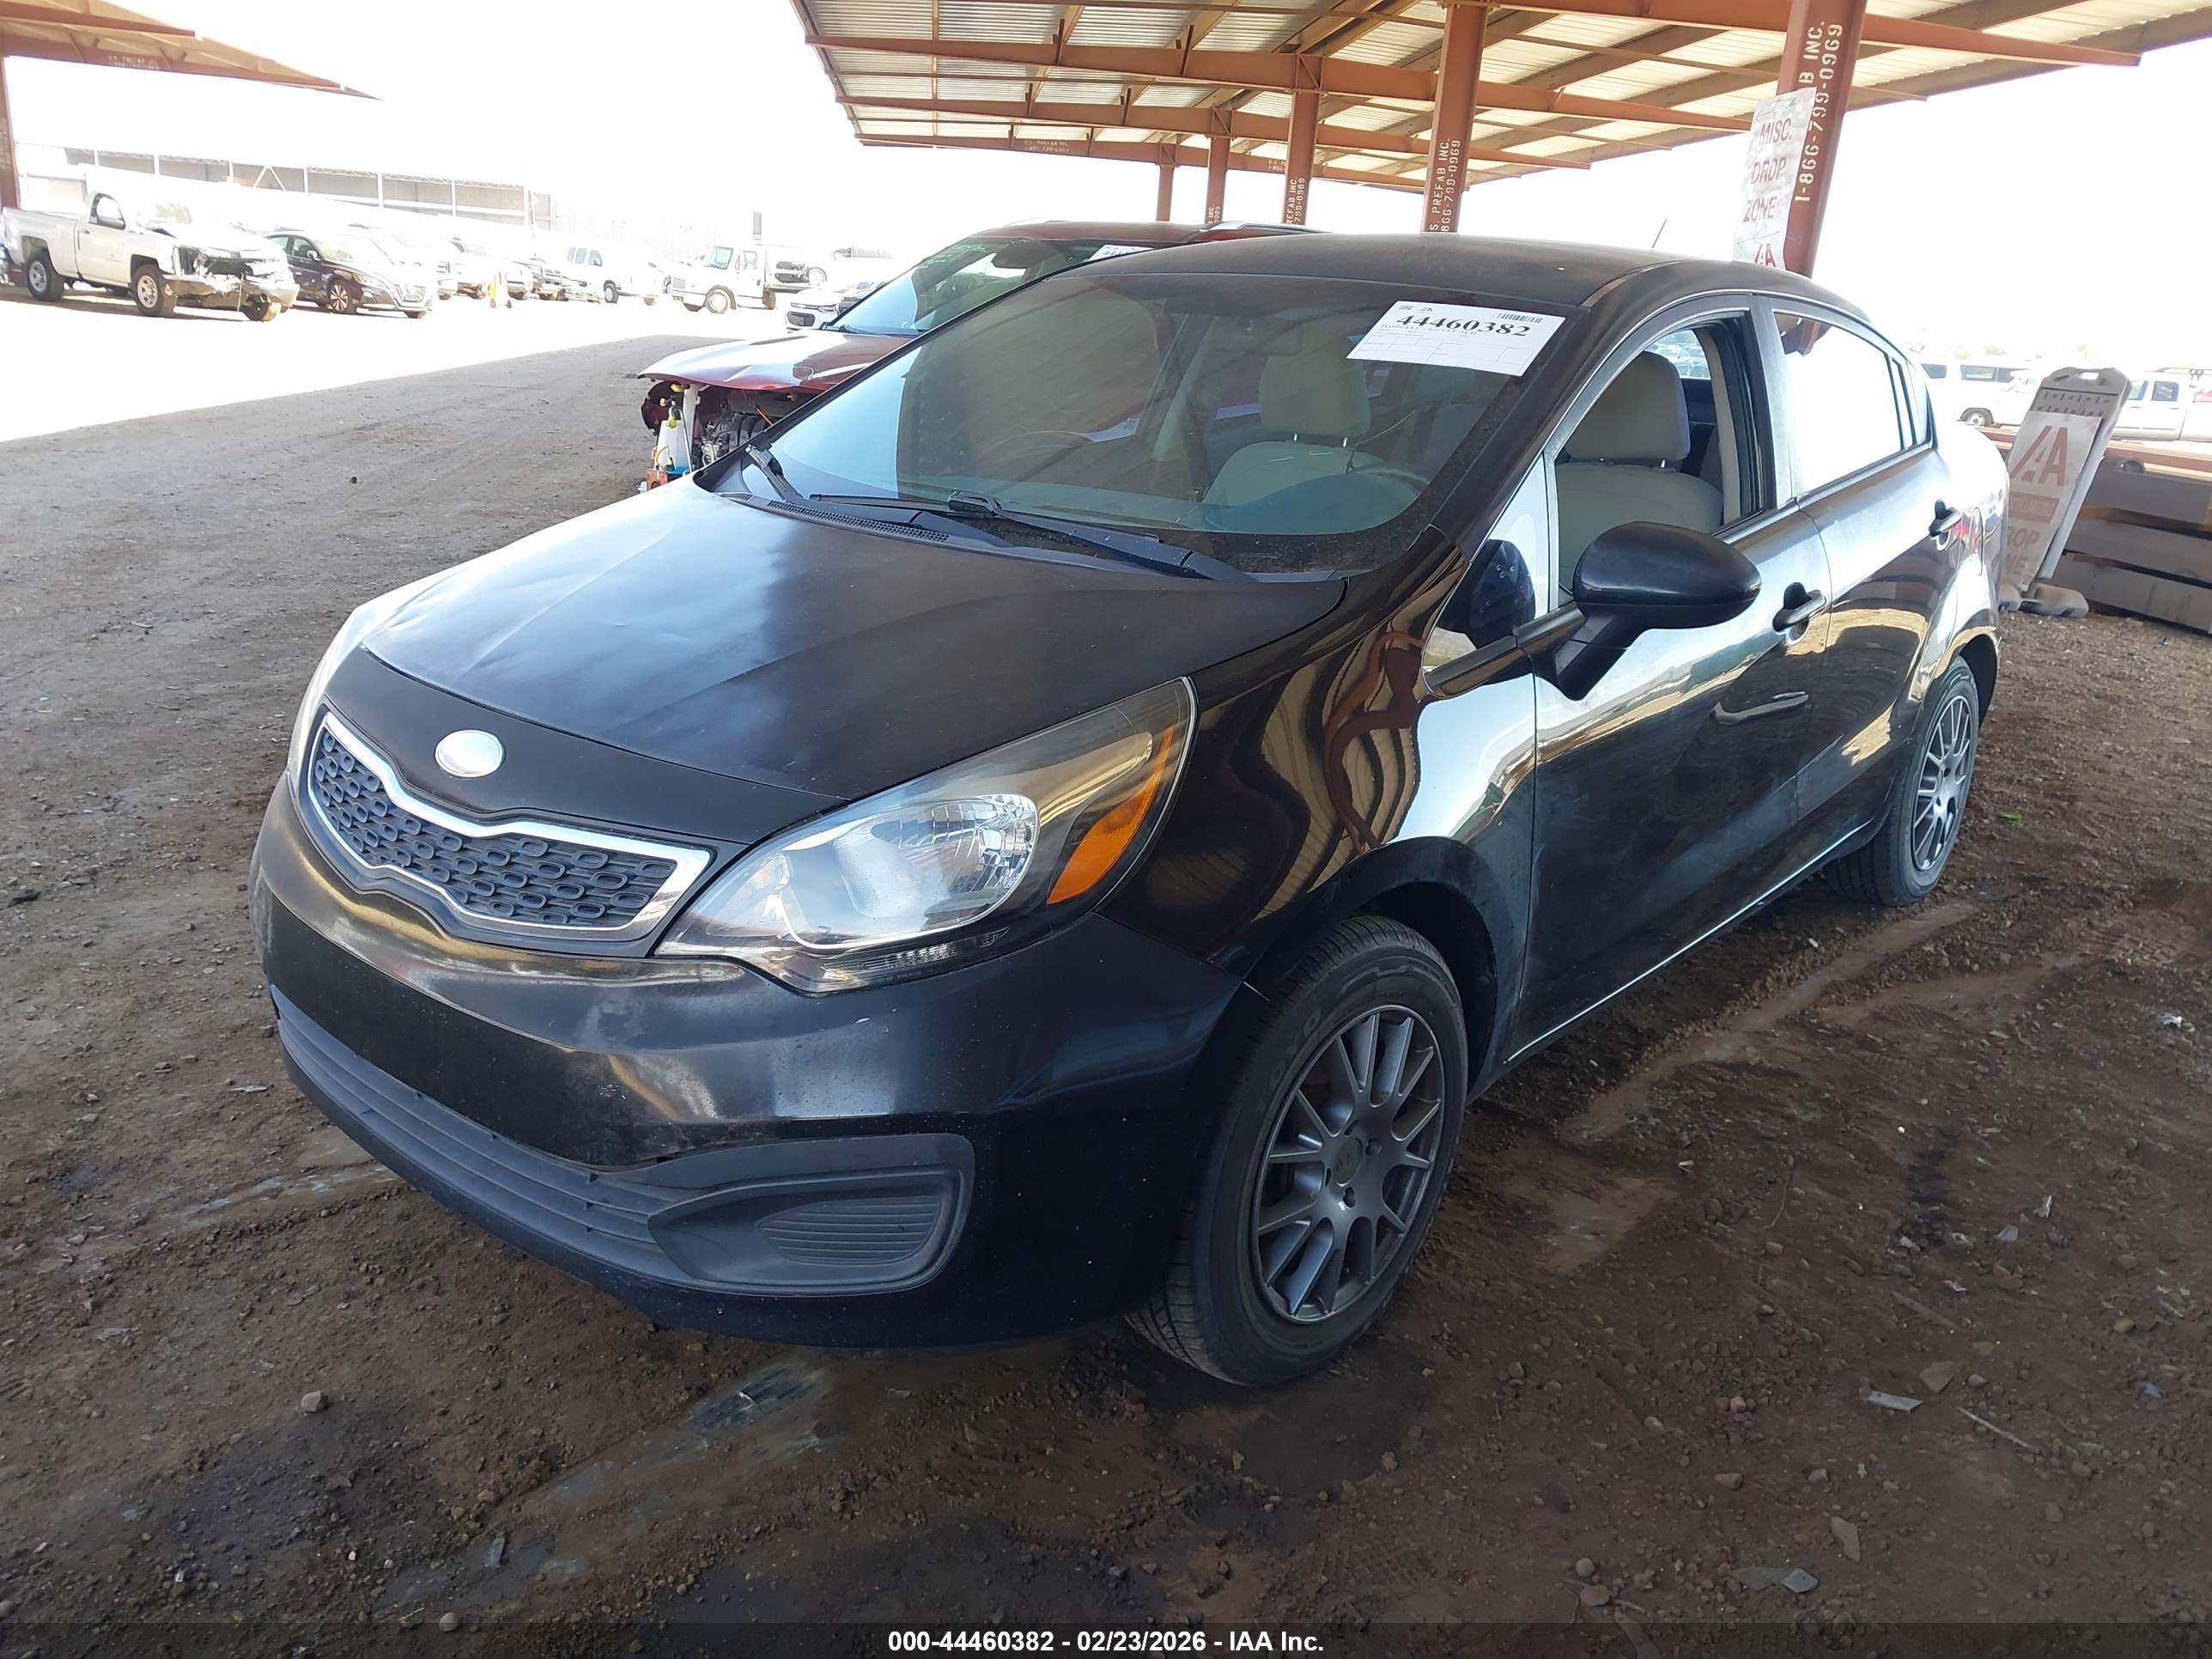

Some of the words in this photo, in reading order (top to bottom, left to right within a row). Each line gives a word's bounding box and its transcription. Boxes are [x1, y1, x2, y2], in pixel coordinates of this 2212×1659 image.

[1803, 21, 1824, 60] INC.
[1795, 24, 1844, 202] 1-866-799-0969
[1759, 118, 1792, 146] MISC.
[1438, 138, 1450, 161] INC.
[1751, 156, 1787, 185] DROP
[1431, 167, 1446, 214] PREFAB
[1742, 196, 1778, 222] ZONE
[1396, 314, 1532, 337] 44460382
